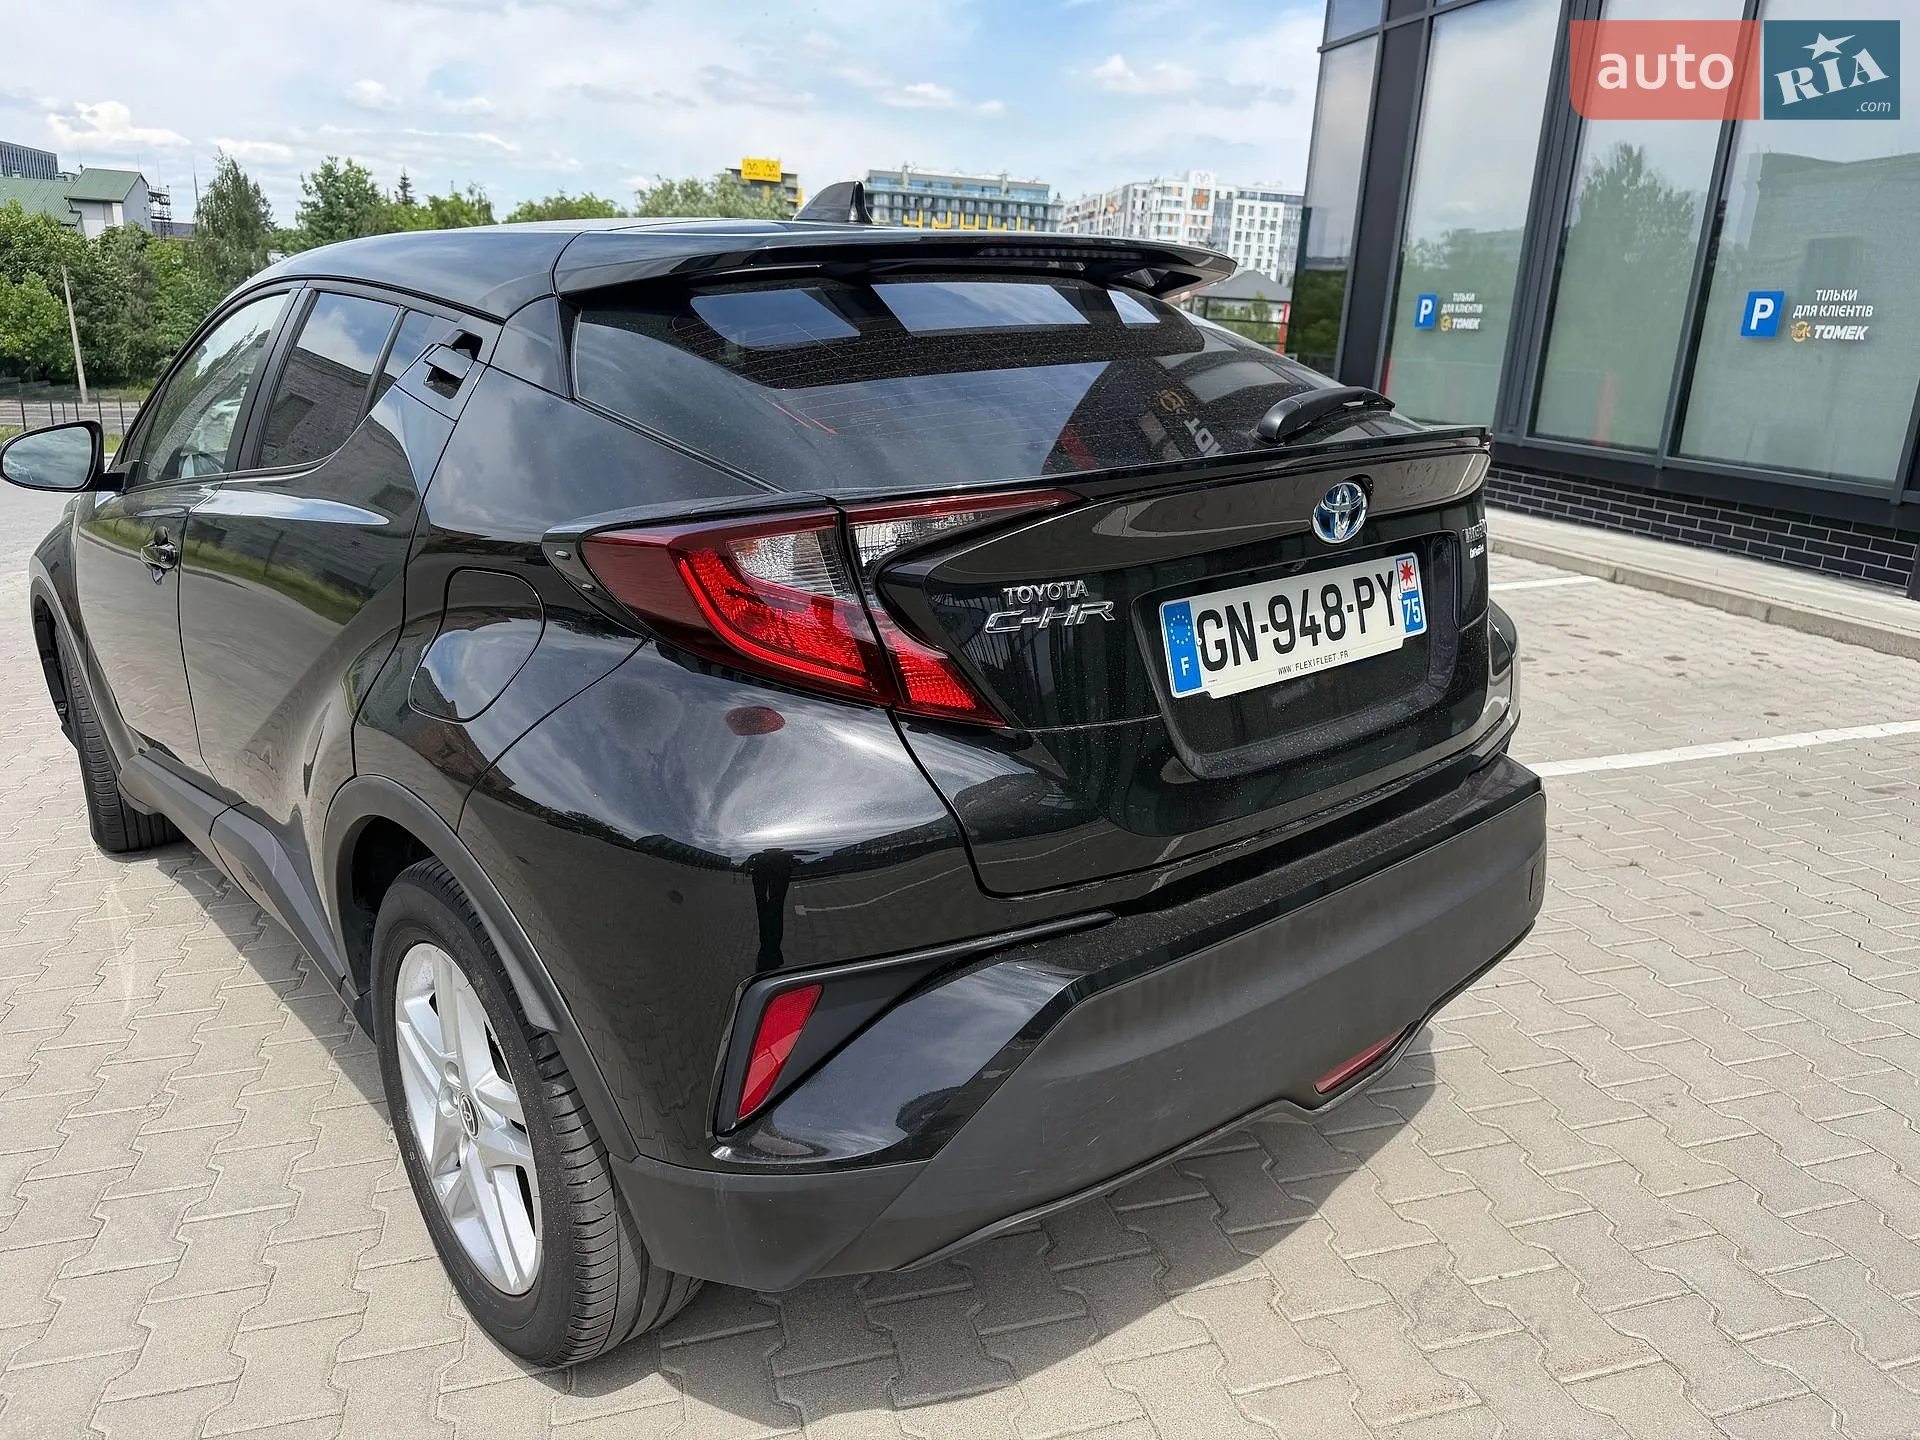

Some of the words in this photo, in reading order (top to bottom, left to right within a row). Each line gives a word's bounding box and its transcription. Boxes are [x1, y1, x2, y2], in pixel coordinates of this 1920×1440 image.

[1815, 289, 1858, 302] ТІЛЬКИ
[1792, 304, 1818, 319] ДЛЯ
[1819, 305, 1874, 318] КЛІЄНТІВ
[1002, 580, 1090, 605] TOYOTA
[985, 601, 1116, 634] C-HR
[1196, 569, 1396, 673] GN-948-PY
[1402, 597, 1422, 626] 75
[1180, 656, 1190, 677] F
